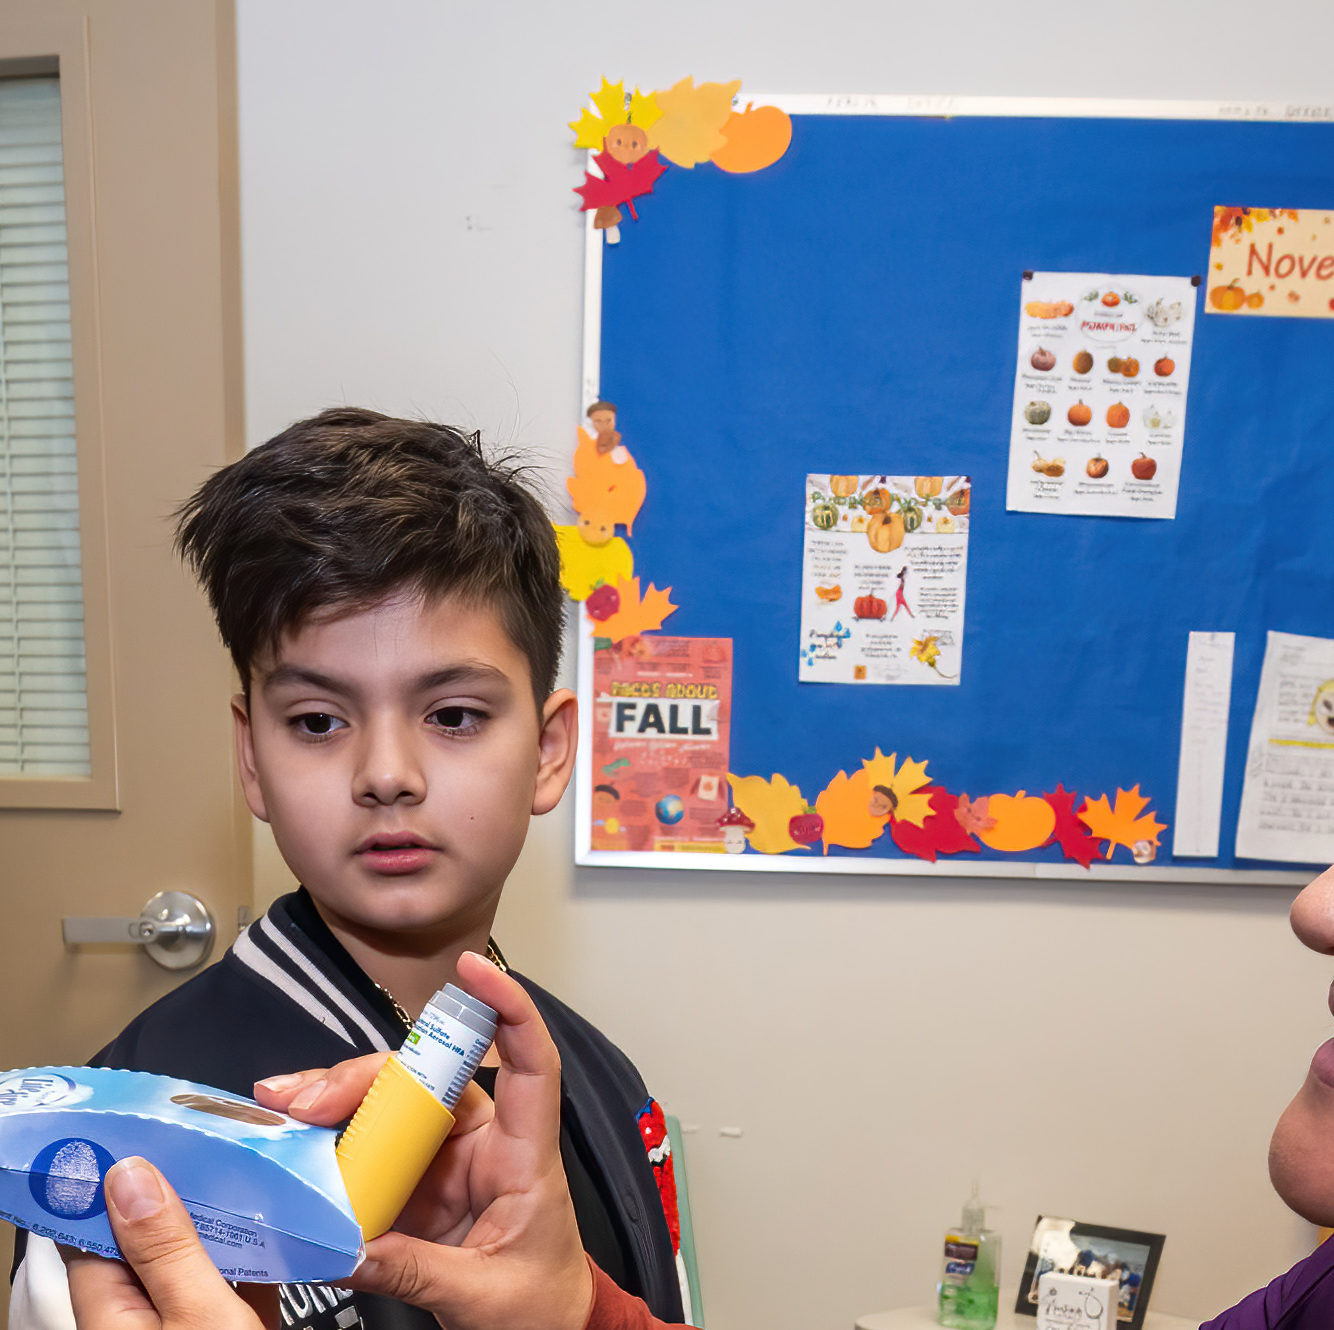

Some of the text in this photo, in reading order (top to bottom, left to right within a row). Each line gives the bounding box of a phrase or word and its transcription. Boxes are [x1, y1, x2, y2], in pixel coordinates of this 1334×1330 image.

[615, 702, 712, 736] FALL
[430, 1022, 451, 1040] Sulfate
[428, 1031, 453, 1049] Aerosol
[452, 1045, 466, 1057] HFA
[18, 1078, 54, 1093] Lite
[216, 1219, 258, 1237] Corporation
[198, 1231, 243, 1249] medical.com
[238, 1267, 269, 1278] Patents
